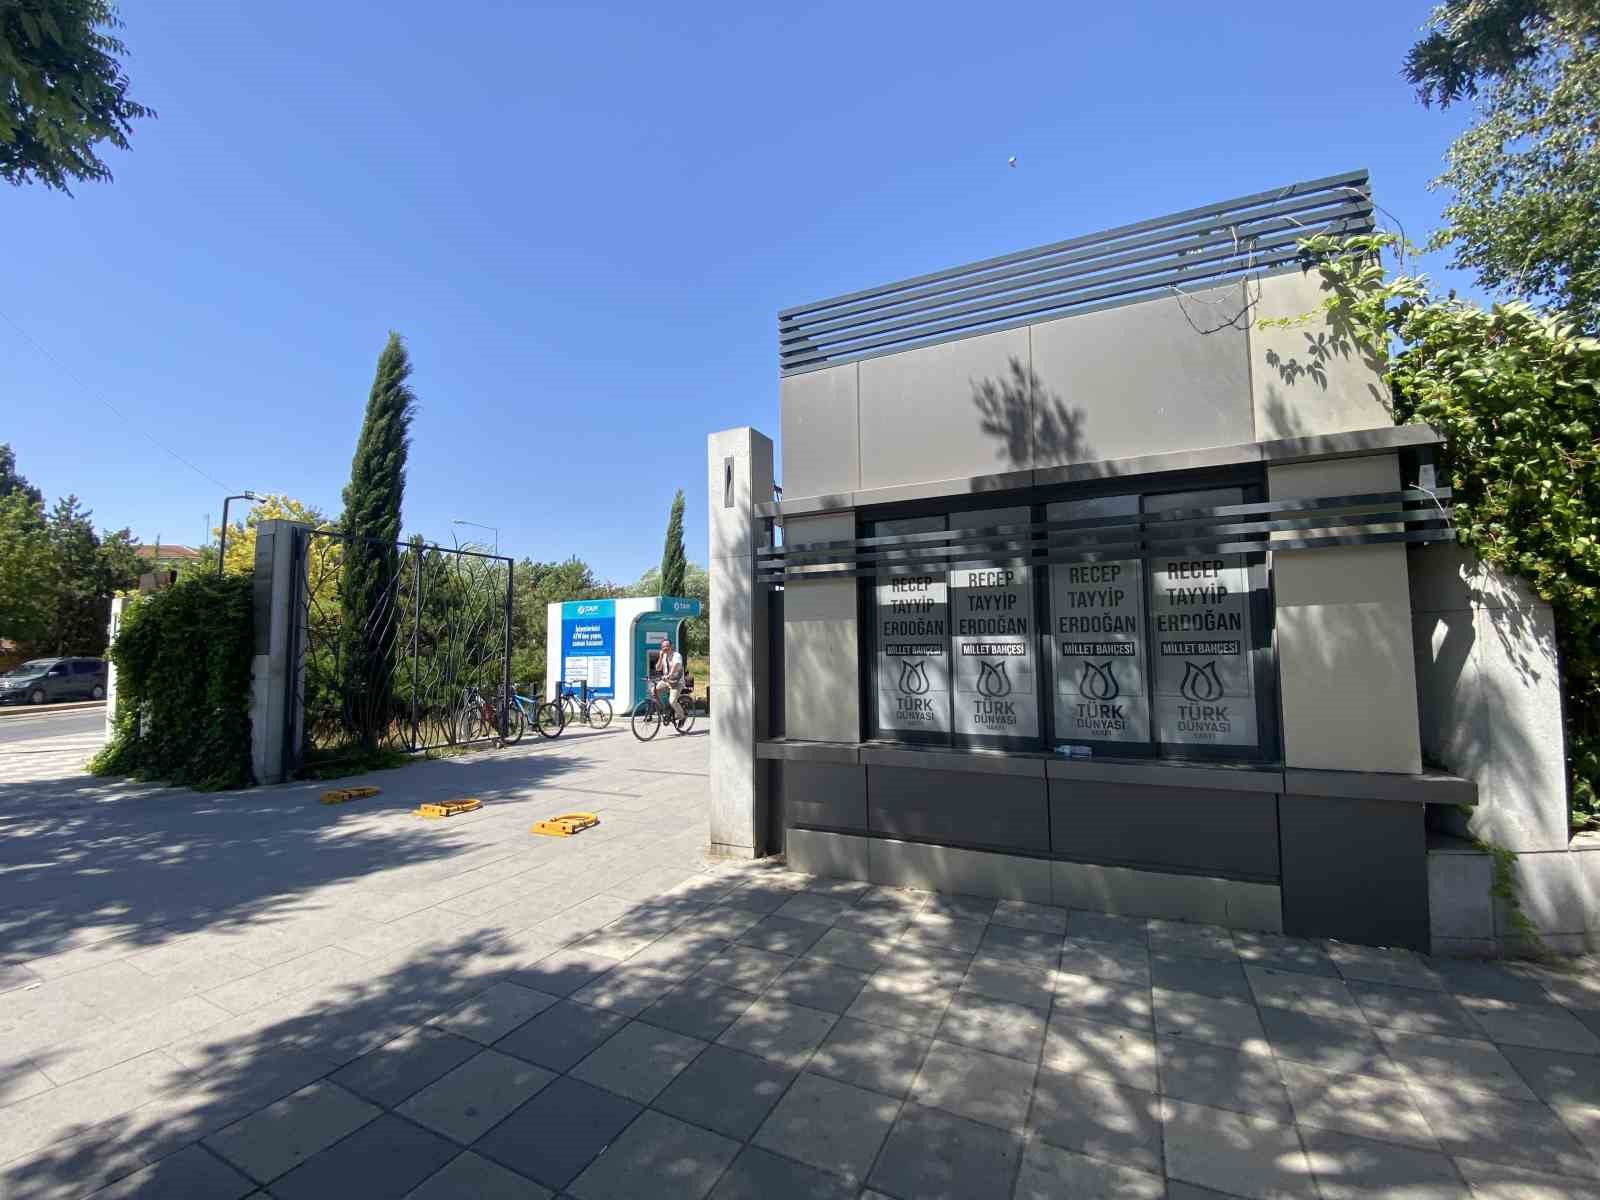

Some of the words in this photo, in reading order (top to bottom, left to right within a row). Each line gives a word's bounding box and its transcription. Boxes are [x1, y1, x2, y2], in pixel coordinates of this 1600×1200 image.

[968, 571, 1014, 588] RECEP
[1070, 566, 1121, 584] RECEP
[1167, 561, 1224, 580] RECEP
[892, 577, 932, 592] RECEP
[967, 592, 1016, 611] TAYYİP
[1067, 587, 1124, 608] TAYYİP
[1166, 583, 1228, 605] TAYYİP
[890, 596, 935, 614] TAYYİP
[884, 617, 944, 636] ERDOĞAN
[960, 614, 1027, 635] ERDOĞAN
[1060, 612, 1136, 632] ERDOĞAN
[1158, 610, 1241, 631] ERDOĞAN
[991, 643, 1025, 655] BAHÇESİ
[896, 696, 933, 711] TÜRK
[973, 698, 1015, 714] TÜRK
[1077, 701, 1123, 719] TÜRK
[1177, 702, 1230, 721] TÜRK
[974, 713, 1016, 725] DÜNYASI
[1077, 717, 1126, 730] DÜNYASI
